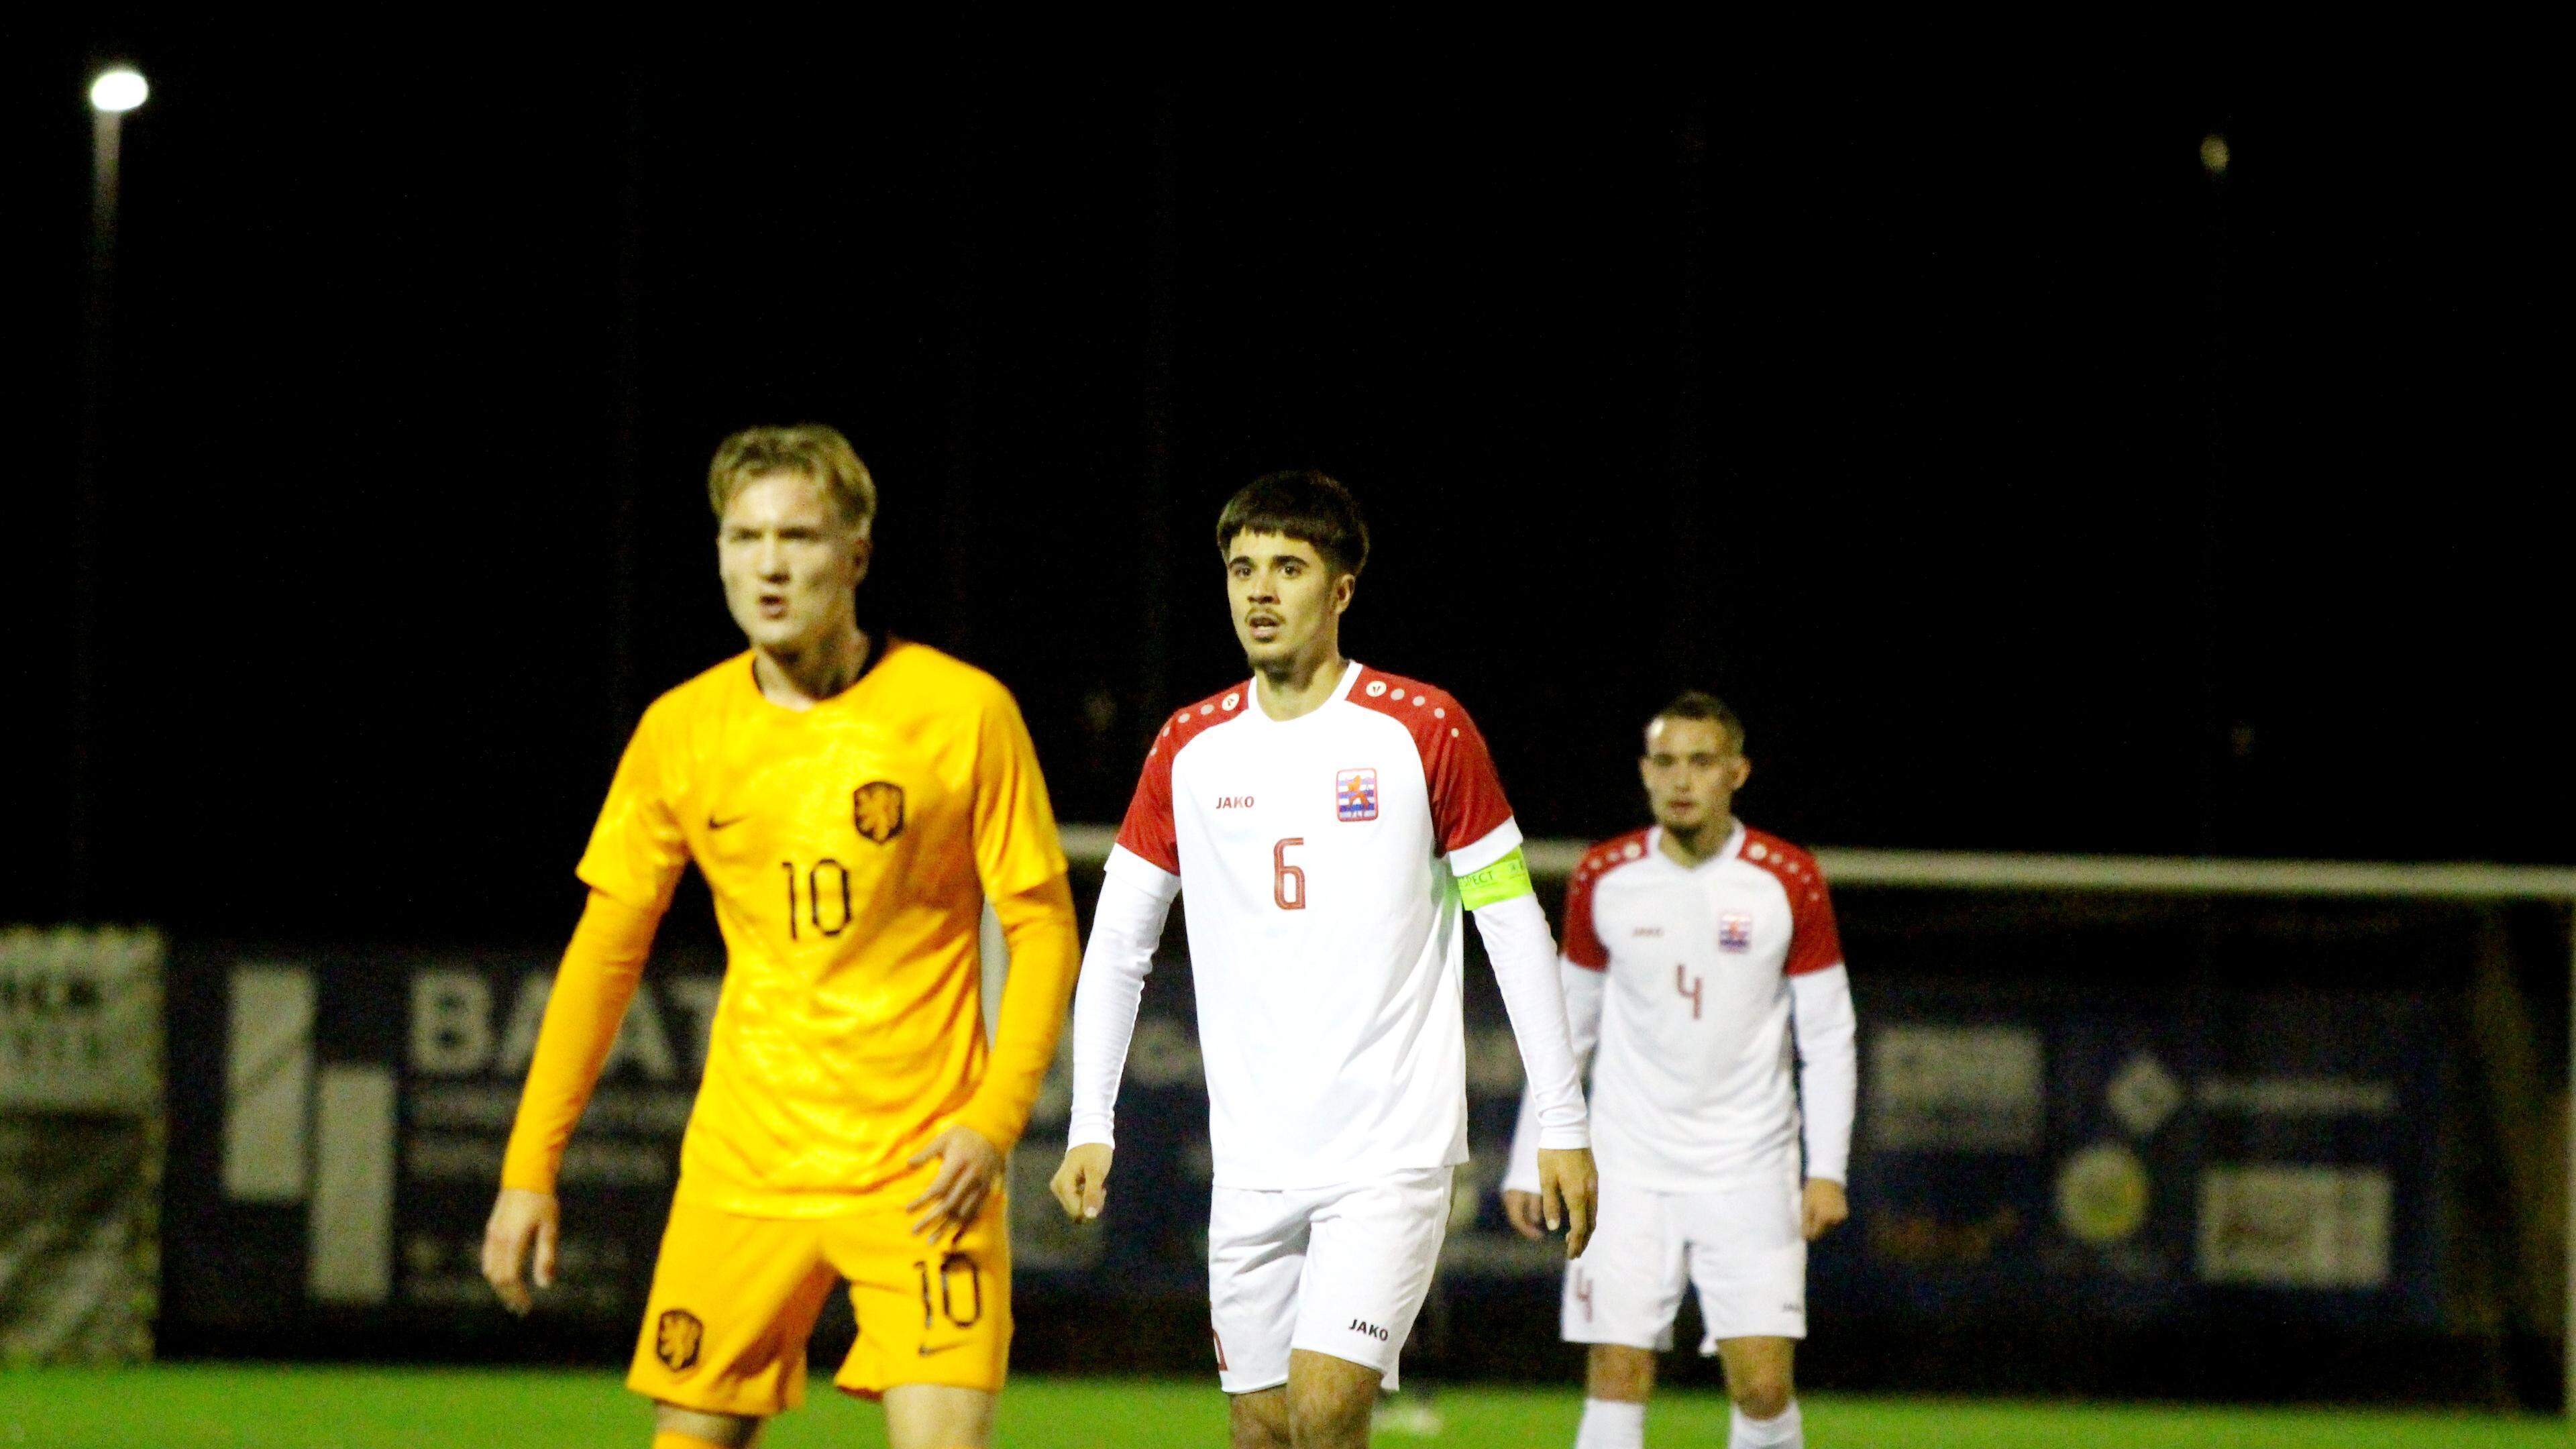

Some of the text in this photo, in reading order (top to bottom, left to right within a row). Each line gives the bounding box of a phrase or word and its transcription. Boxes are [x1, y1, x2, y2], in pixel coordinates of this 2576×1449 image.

[1216, 796, 1254, 809] JAKO
[781, 857, 853, 942] 10
[1273, 837, 1305, 910] 6
[1676, 963, 1703, 1020] 4
[914, 1251, 982, 1329] 10
[1348, 1319, 1389, 1342] JAKO
